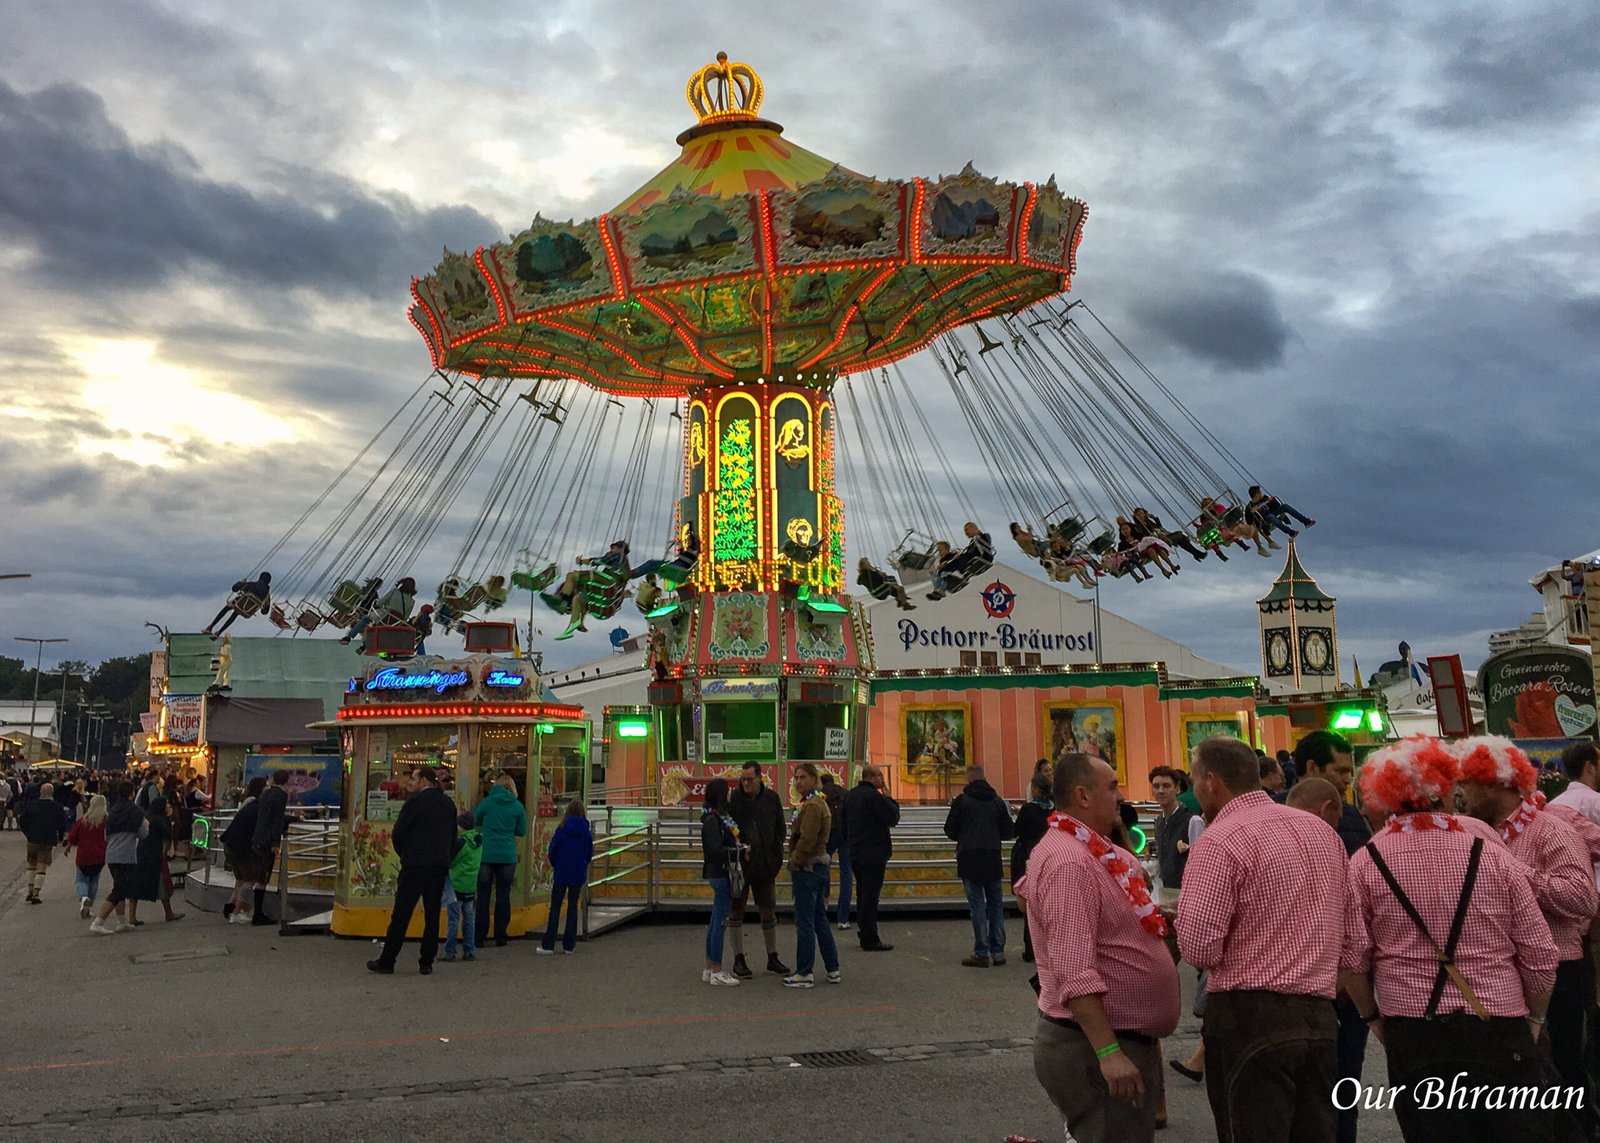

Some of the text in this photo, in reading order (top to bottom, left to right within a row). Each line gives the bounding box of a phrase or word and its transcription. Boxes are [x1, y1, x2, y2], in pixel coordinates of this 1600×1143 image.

[897, 618, 1095, 652] Pschorr-Bräurosl
[1545, 661, 1571, 674] echte
[1489, 681, 1542, 704] Baccara
[1546, 674, 1592, 697] Rosen
